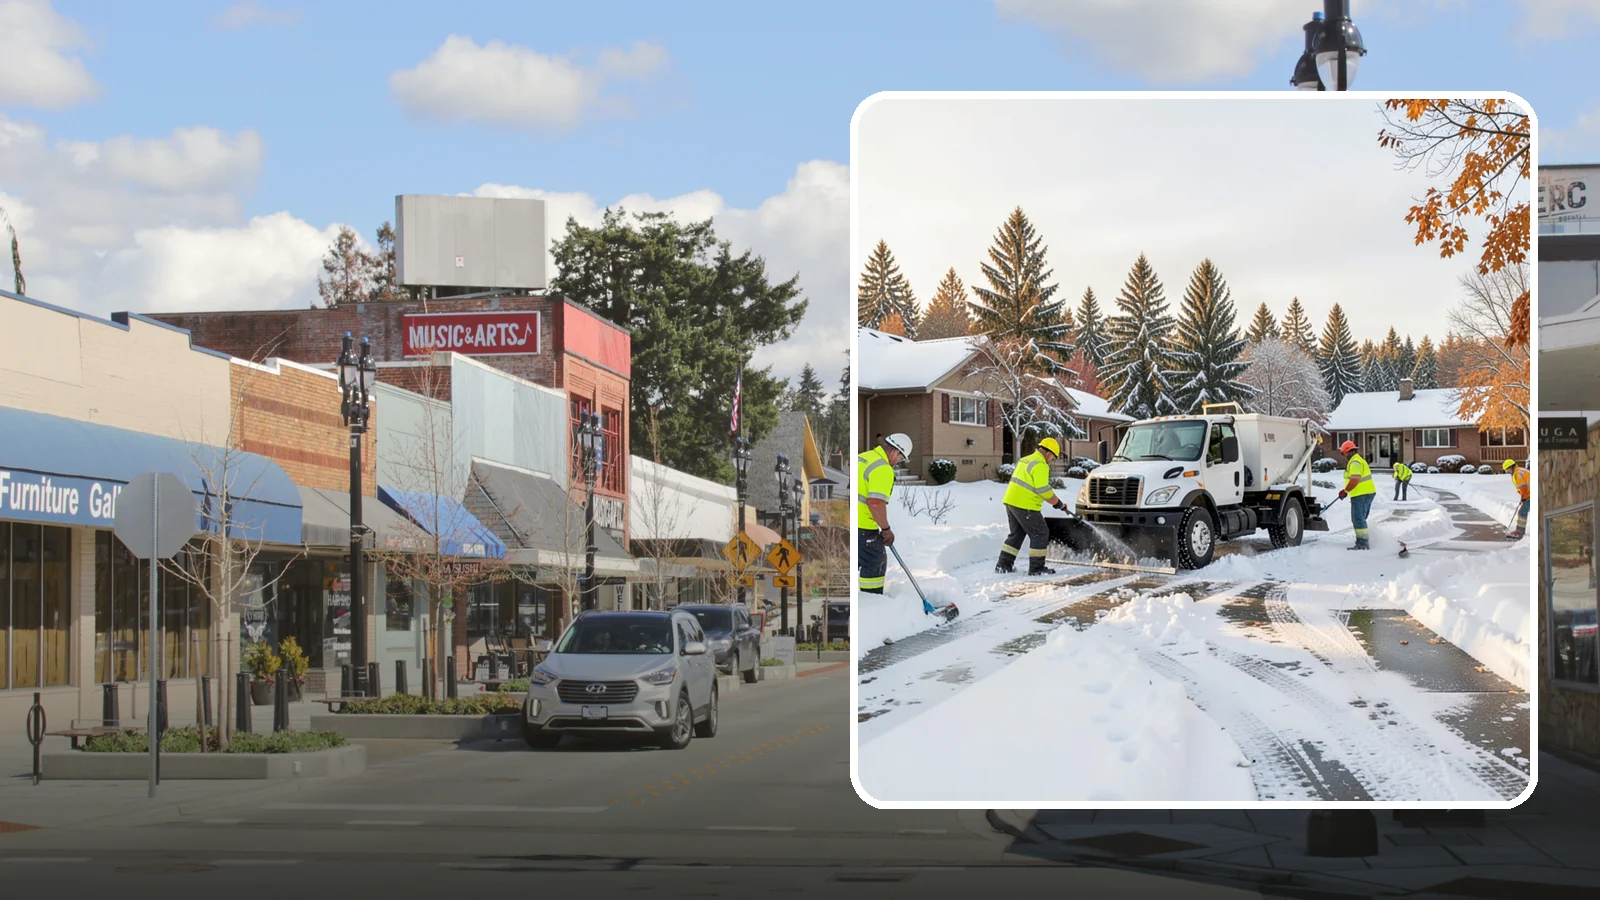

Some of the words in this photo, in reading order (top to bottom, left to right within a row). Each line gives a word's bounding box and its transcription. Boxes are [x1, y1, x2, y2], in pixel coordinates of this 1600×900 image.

[1540, 427, 1577, 436] UGA
[0, 471, 79, 515] Furniture
[89, 482, 121, 519] Gal
[453, 563, 479, 575] SUSHI
